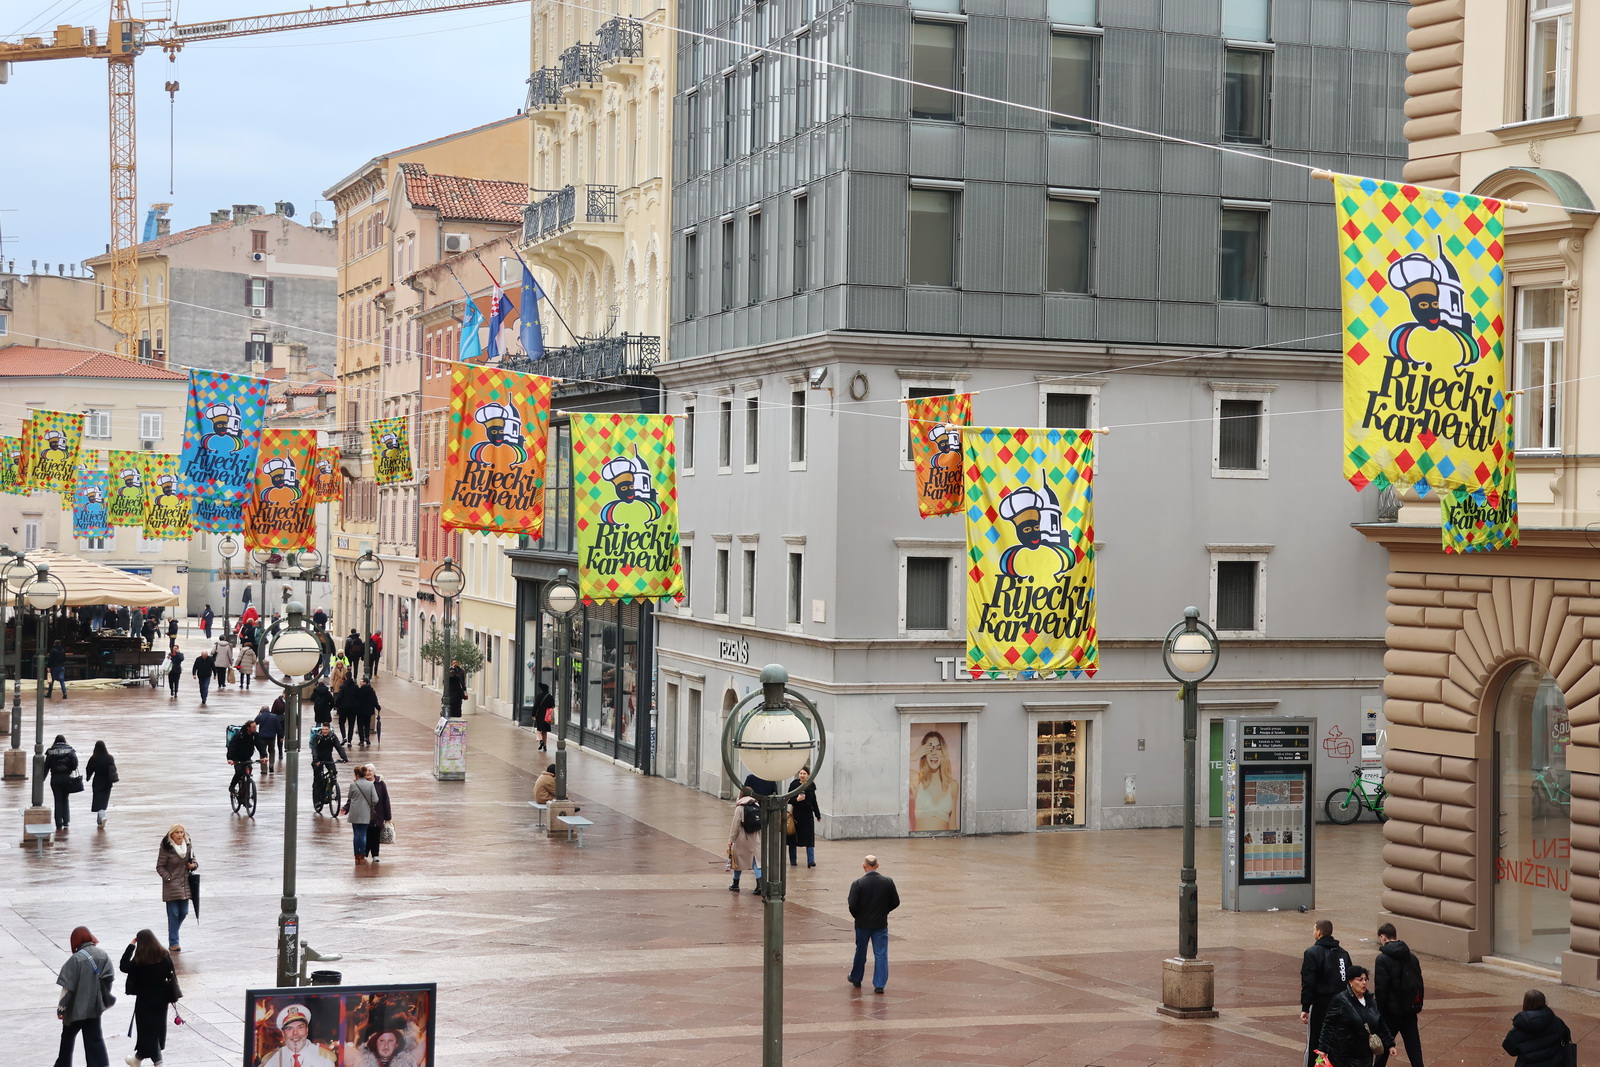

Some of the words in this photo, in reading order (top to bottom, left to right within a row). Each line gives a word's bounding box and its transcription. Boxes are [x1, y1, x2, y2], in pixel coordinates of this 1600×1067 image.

[1380, 355, 1494, 420] Riječki
[1362, 390, 1498, 452] karneval
[32, 466, 74, 481] karneval
[37, 457, 74, 474] Riječki
[184, 460, 250, 487] karneval
[194, 446, 249, 474] Riječki
[462, 460, 536, 502] Riječki
[928, 465, 965, 488] Riječk
[113, 495, 144, 510] Riječk
[451, 480, 537, 511] karneval
[80, 510, 107, 523] Riječk
[146, 514, 189, 528] karneval
[150, 504, 188, 522] Riječki
[196, 503, 243, 521] karneval
[251, 513, 311, 535] karneval
[258, 500, 308, 527] Riječki
[1449, 498, 1514, 530] karneval
[595, 522, 672, 562] Riječki
[586, 543, 675, 576] karneval
[991, 574, 1088, 618] Riječki
[978, 601, 1091, 643] karneval
